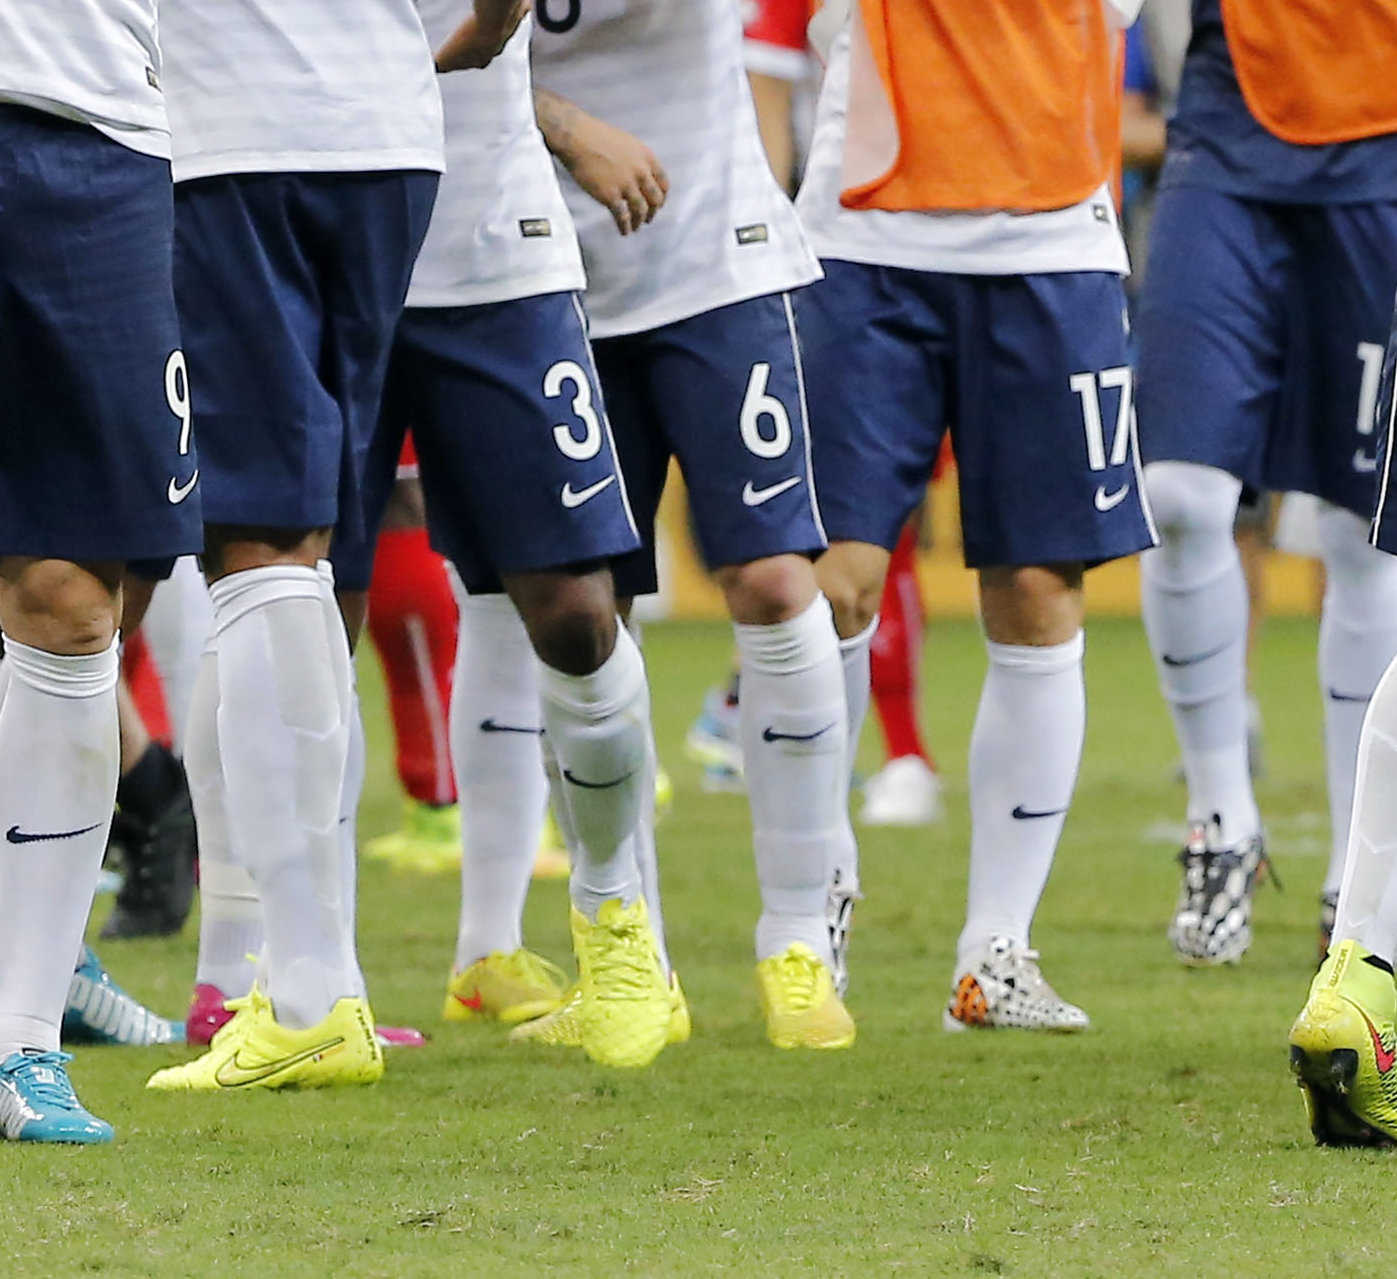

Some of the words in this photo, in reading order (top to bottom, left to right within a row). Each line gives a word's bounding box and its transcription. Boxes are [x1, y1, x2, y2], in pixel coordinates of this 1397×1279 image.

[165, 349, 192, 455] 9
[543, 360, 602, 461] 3
[739, 362, 792, 459] 6
[1069, 365, 1134, 471] 17
